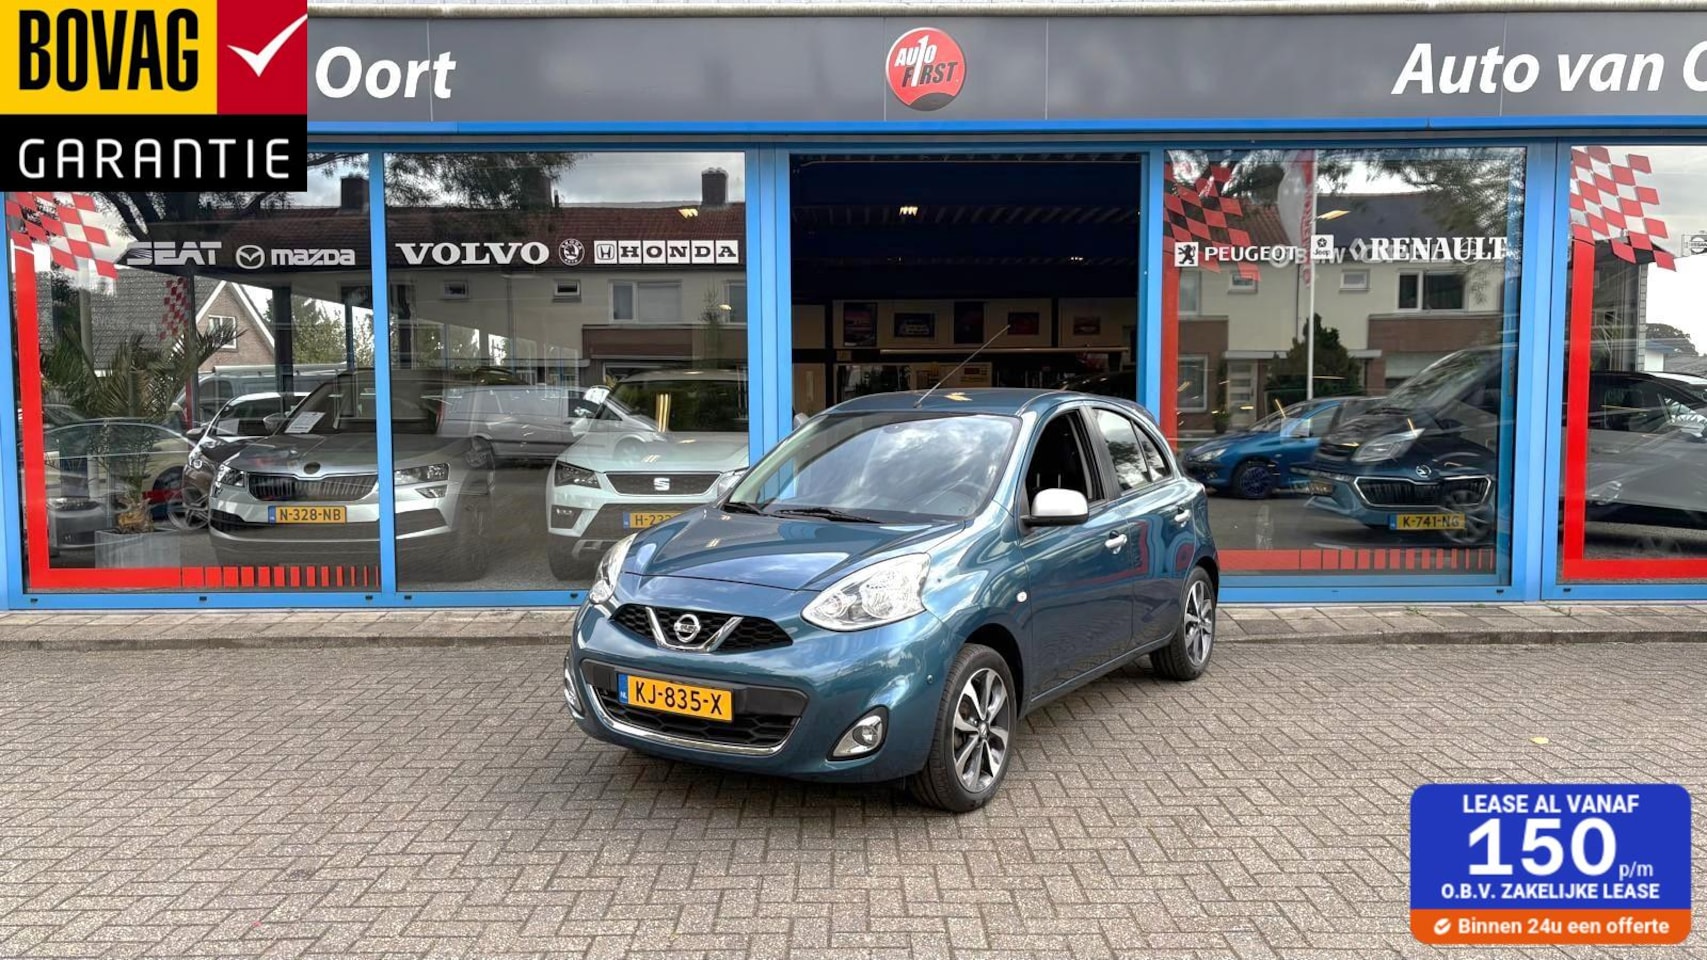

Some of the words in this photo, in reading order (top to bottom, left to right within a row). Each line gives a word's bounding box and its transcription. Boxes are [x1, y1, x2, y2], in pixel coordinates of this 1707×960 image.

[315, 46, 457, 99] Oort
[1390, 43, 1540, 95] Auto
[1557, 52, 1665, 92] van
[127, 241, 222, 266] SEAT
[395, 241, 550, 265] VOLVO
[619, 244, 737, 259] HONDA
[1204, 245, 1299, 262] PEUGEOT
[1369, 236, 1508, 262] RENAULT
[279, 508, 341, 521] N-328-NB
[1402, 515, 1460, 527] K-741-NG
[635, 680, 722, 715] KJ-835-X
